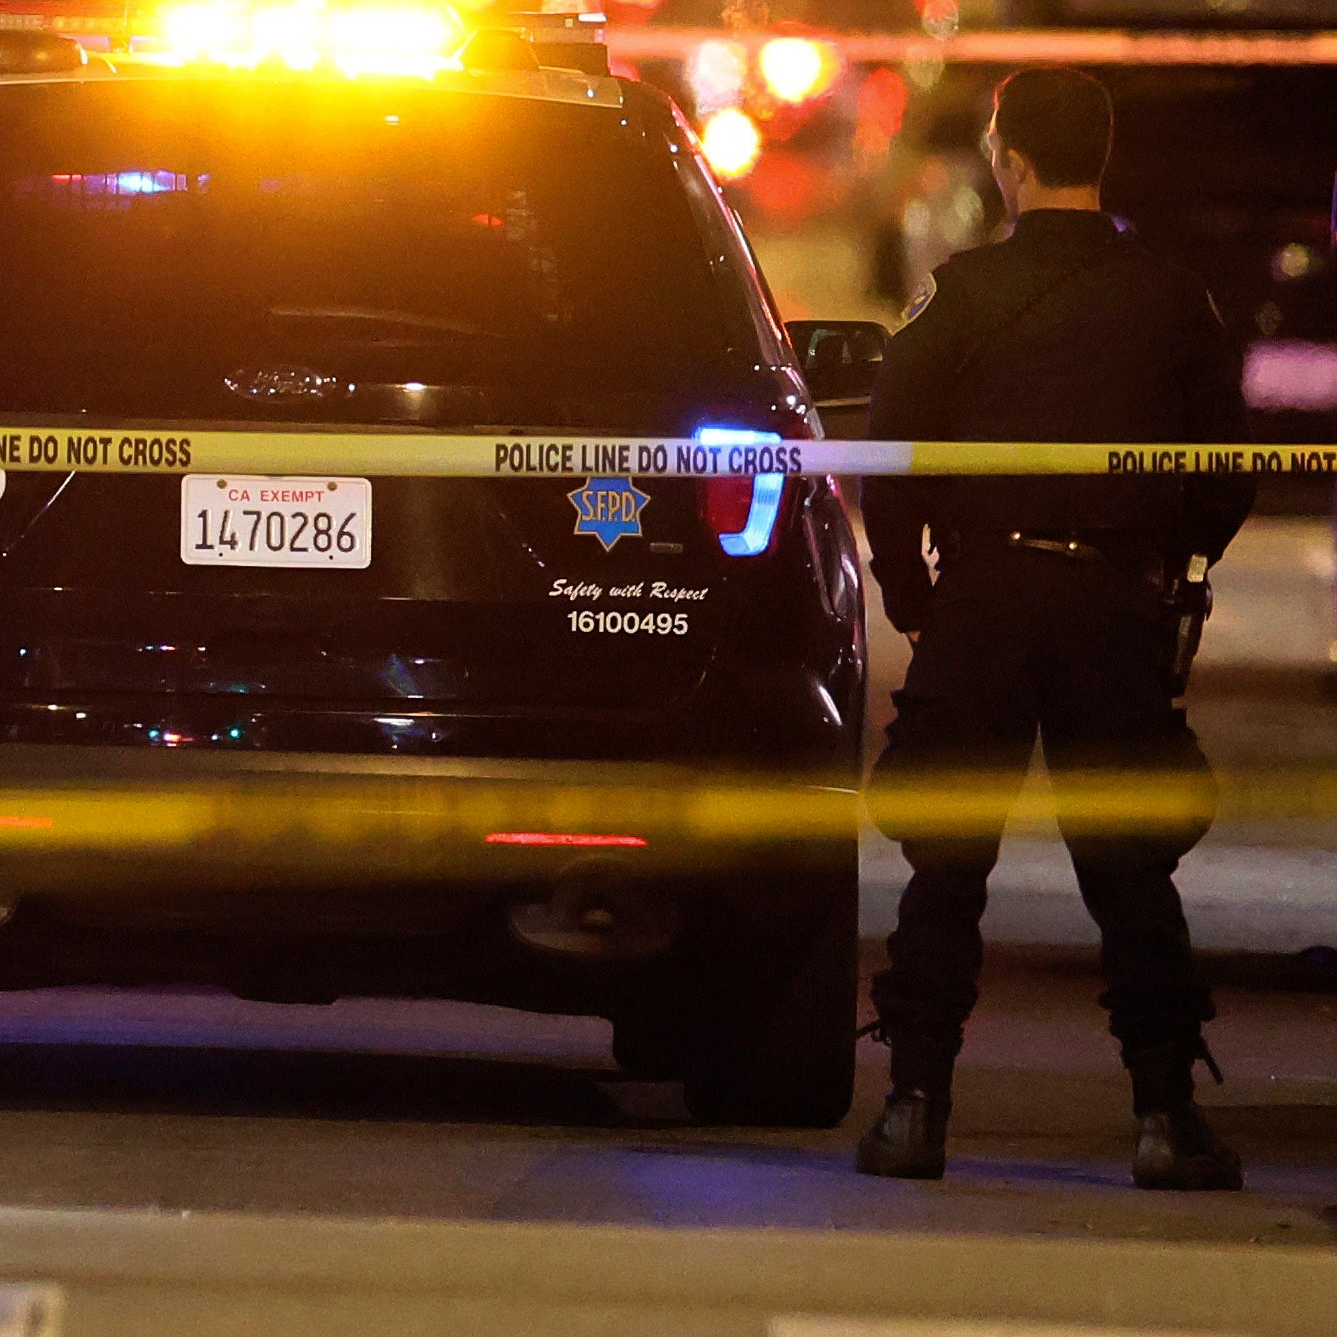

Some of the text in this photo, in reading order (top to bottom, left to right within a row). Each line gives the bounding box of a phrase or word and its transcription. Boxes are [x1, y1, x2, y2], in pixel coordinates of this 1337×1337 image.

[29, 435, 58, 464] DO
[67, 436, 112, 466] NOT
[118, 437, 192, 467] CROSS
[495, 443, 802, 475] POLICE LINE DO NOT CROSS
[1108, 451, 1337, 473] POLICE LINE DO NOT
[228, 489, 325, 503] CA EXEMPT
[195, 509, 357, 553] 1470286
[549, 579, 709, 603] Safety with Respect
[567, 610, 689, 635] 16100495
